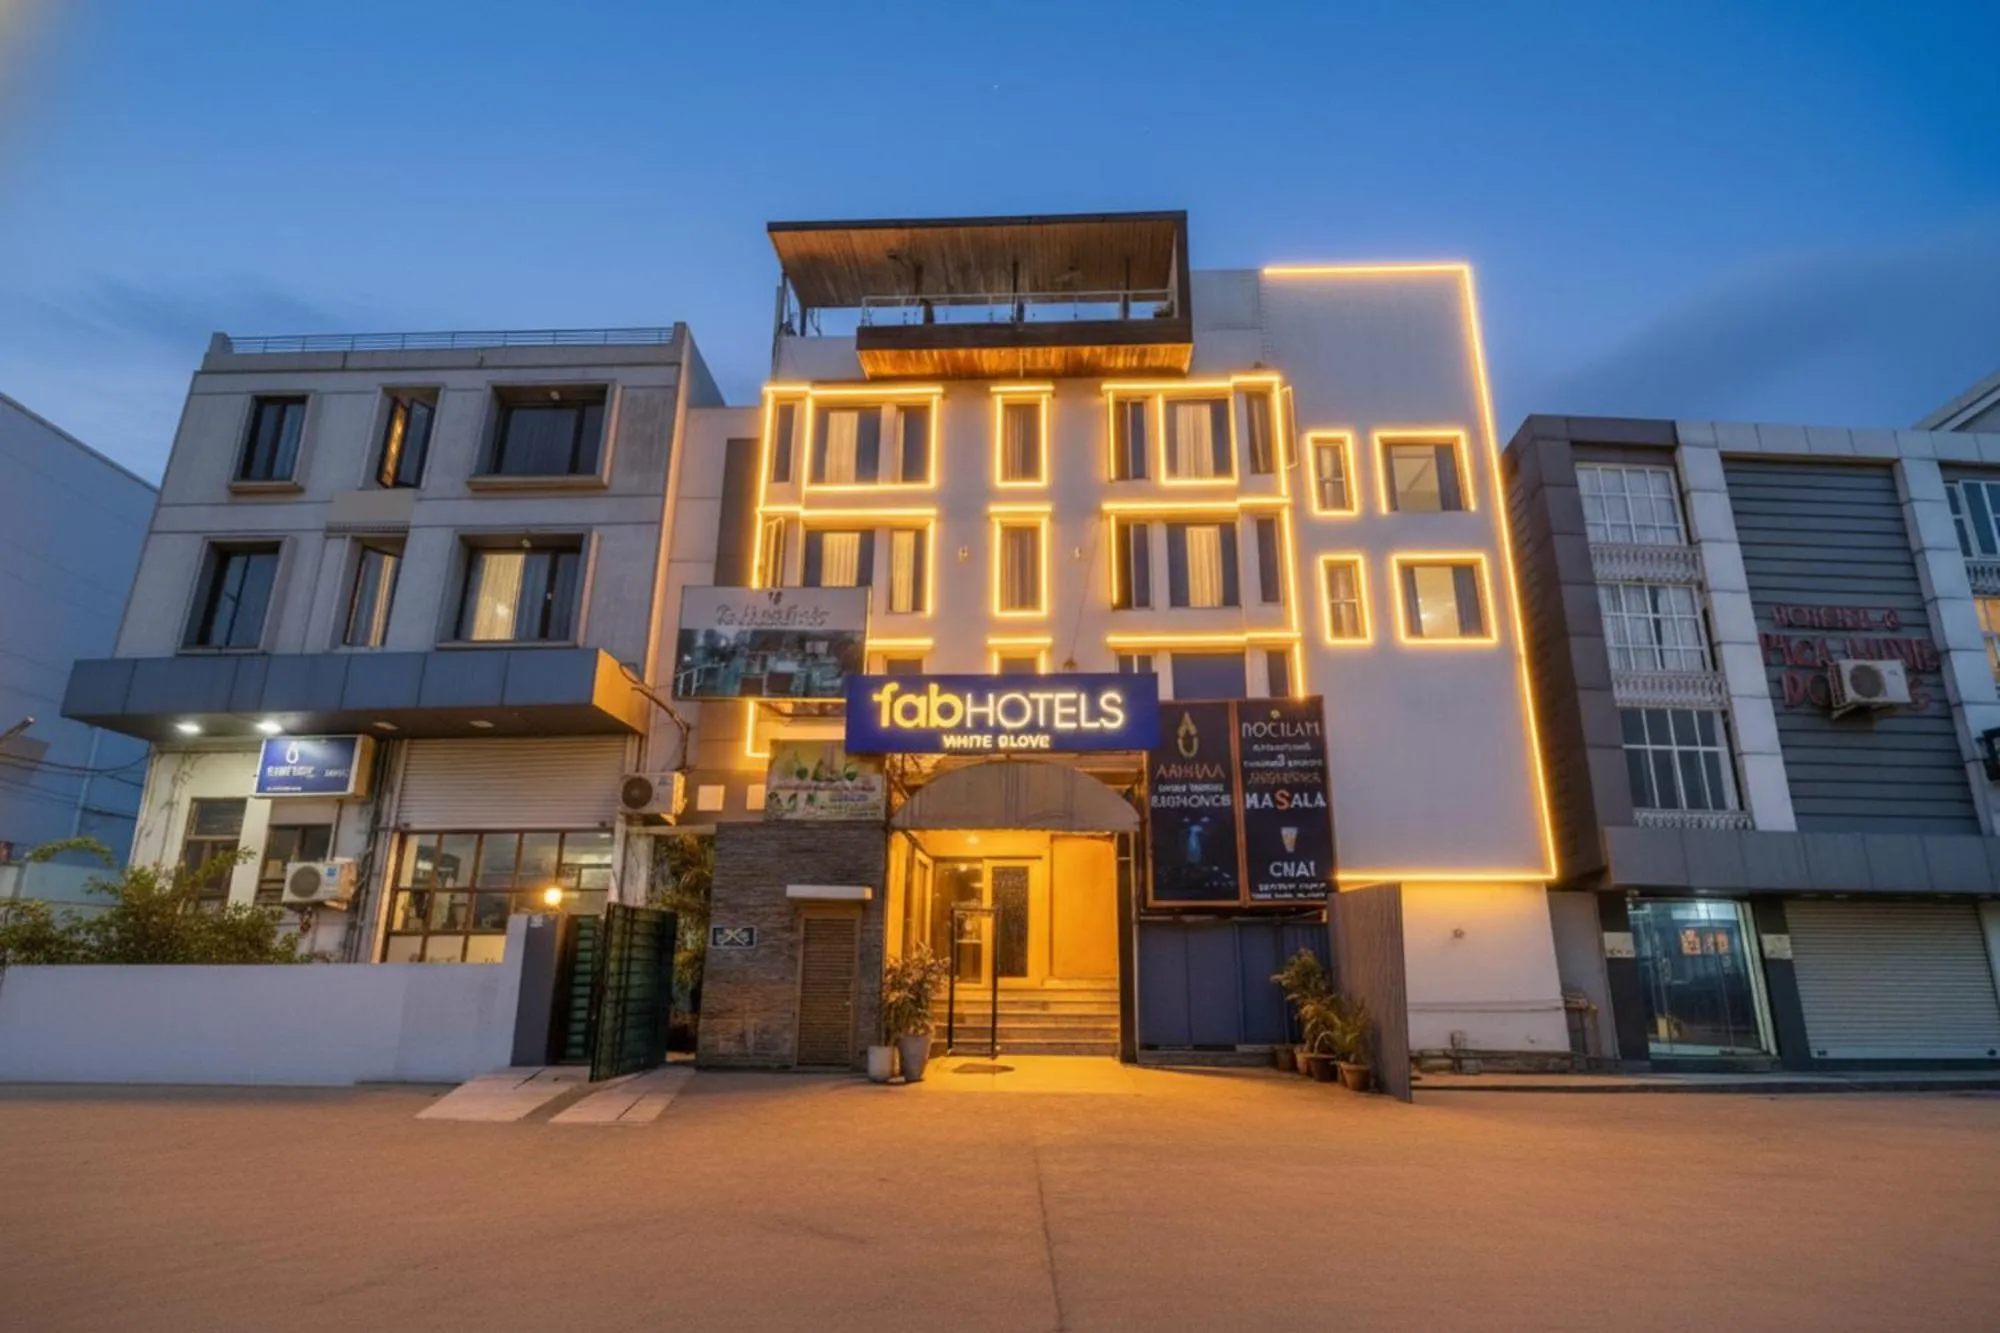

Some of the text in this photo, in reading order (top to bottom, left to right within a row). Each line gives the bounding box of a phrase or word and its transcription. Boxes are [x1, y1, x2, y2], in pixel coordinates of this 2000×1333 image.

[872, 682, 1125, 728] fabHOTELS
[942, 733, 993, 749] WHITE
[1246, 789, 1327, 811] MASALA
